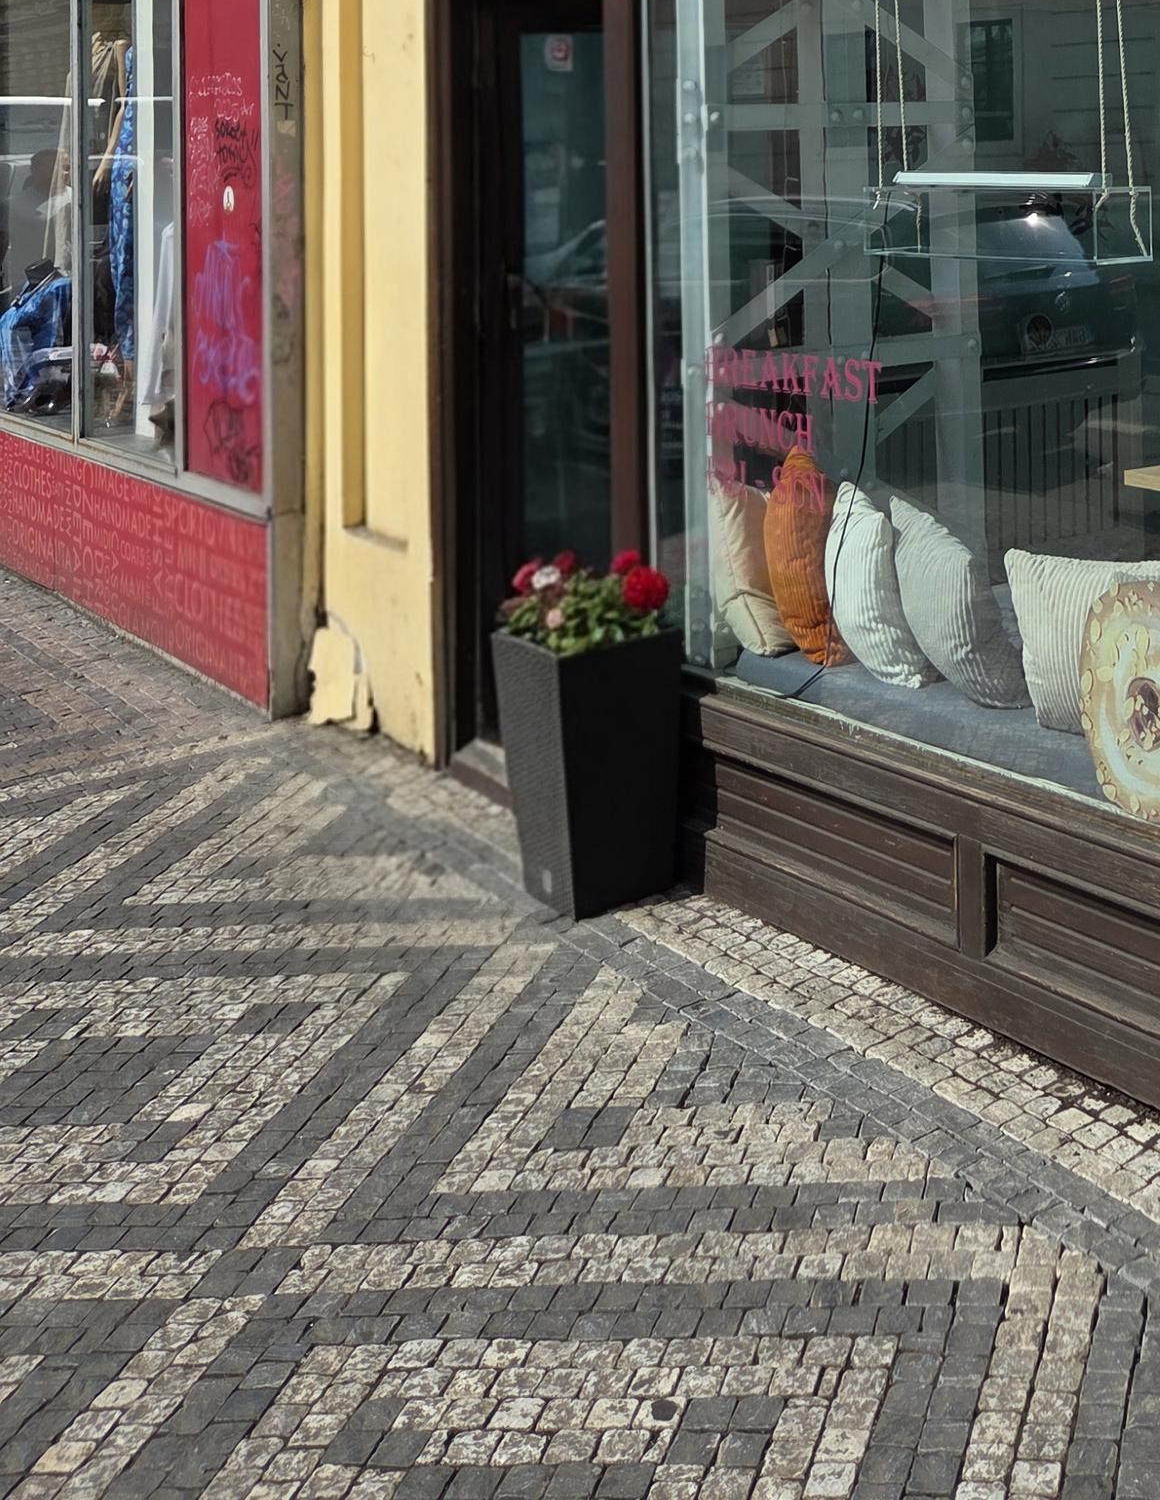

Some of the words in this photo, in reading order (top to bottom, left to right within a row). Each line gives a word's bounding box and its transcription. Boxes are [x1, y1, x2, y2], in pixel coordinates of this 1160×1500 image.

[705, 345, 882, 404] BREAKFAST
[13, 461, 51, 498] CLOTHES
[12, 488, 64, 532] HANDMADE
[94, 494, 151, 541] HANDMADE
